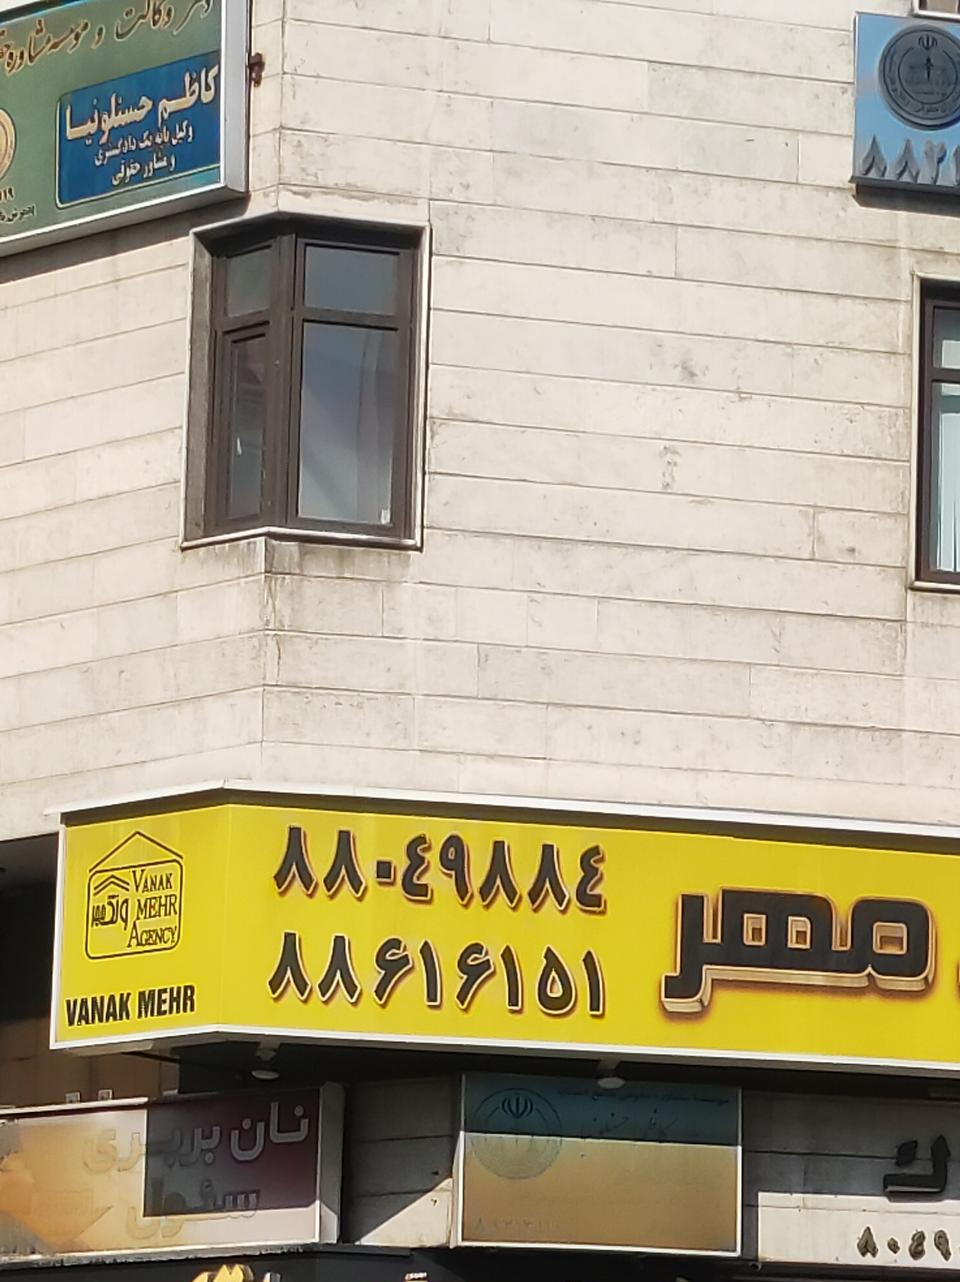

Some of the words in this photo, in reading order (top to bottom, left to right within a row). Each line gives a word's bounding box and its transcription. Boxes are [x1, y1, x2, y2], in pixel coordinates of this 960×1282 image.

[158, 64, 219, 128] کاظم
[136, 894, 178, 921] MEHR
[267, 930, 605, 1017] ۸۸۶۱۶۱۵۱
[661, 885, 937, 1012] مهر
[65, 991, 131, 1027] VANAK
[137, 983, 195, 1019] MEHR
[229, 1101, 309, 1162] نان
